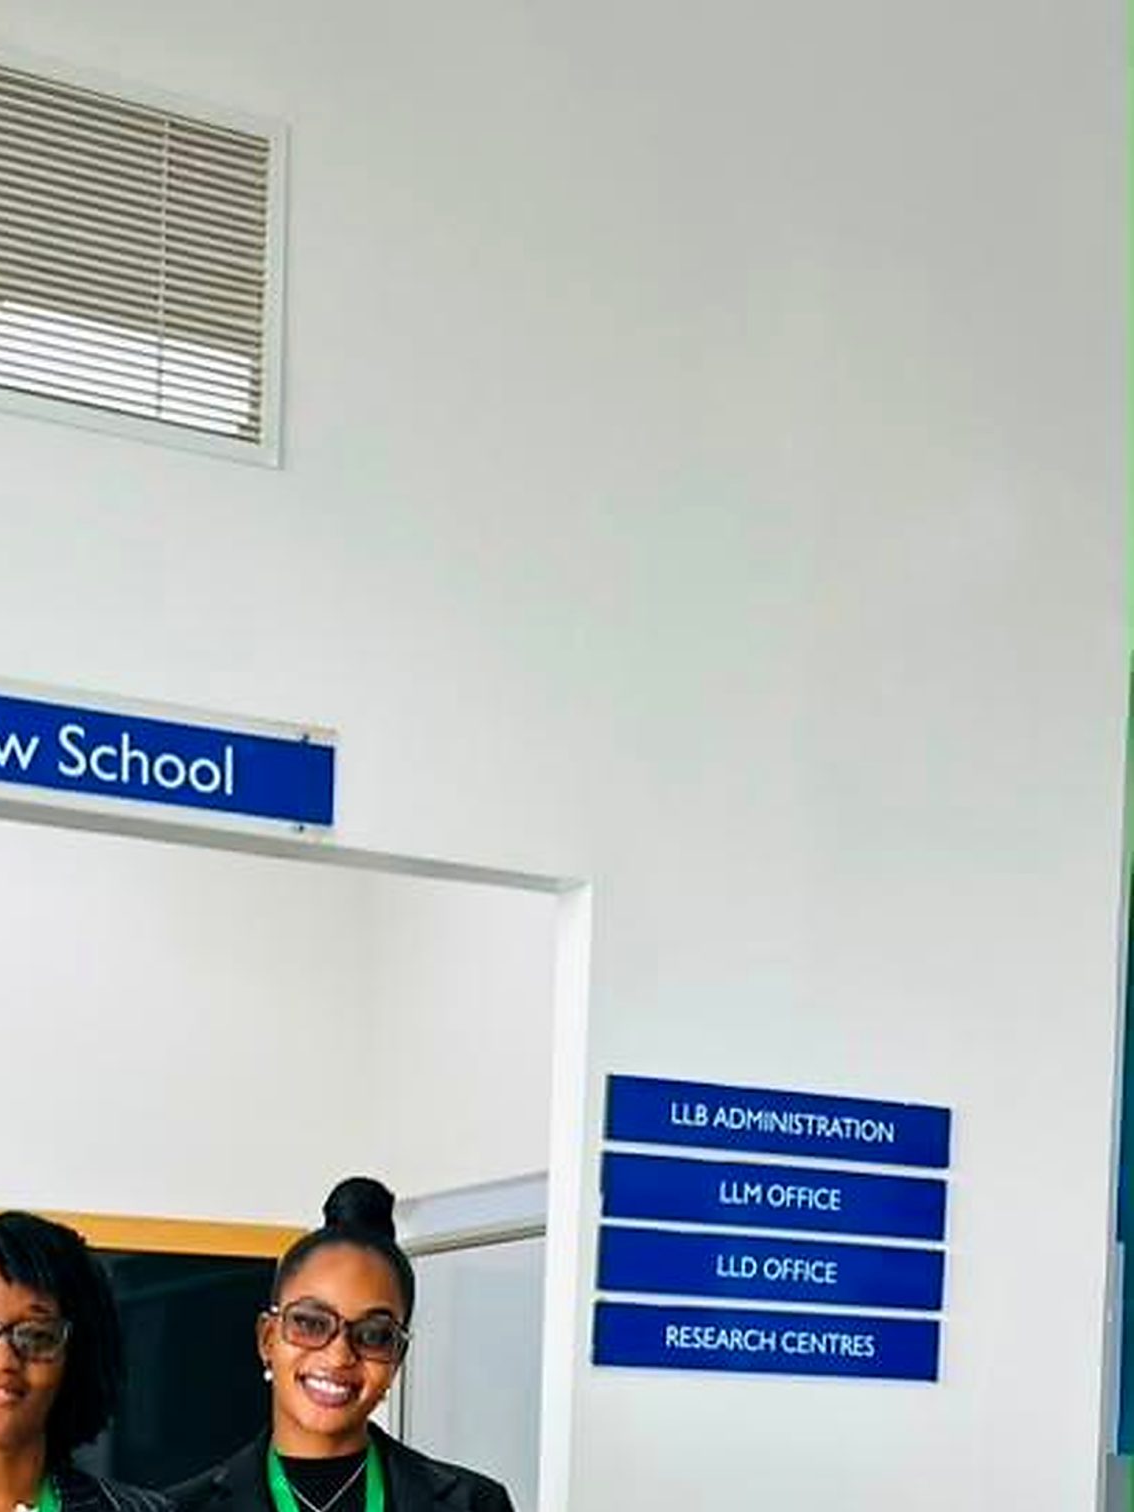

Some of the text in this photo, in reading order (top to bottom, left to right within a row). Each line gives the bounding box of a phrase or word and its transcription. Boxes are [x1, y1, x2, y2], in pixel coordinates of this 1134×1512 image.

[57, 724, 236, 797] School
[670, 1102, 894, 1142] LLB ADMINISTRATION
[719, 1180, 841, 1211] LLM OFFICE
[716, 1254, 838, 1285] LLD OFFICE
[665, 1324, 876, 1358] RESEARCH CENTRES
